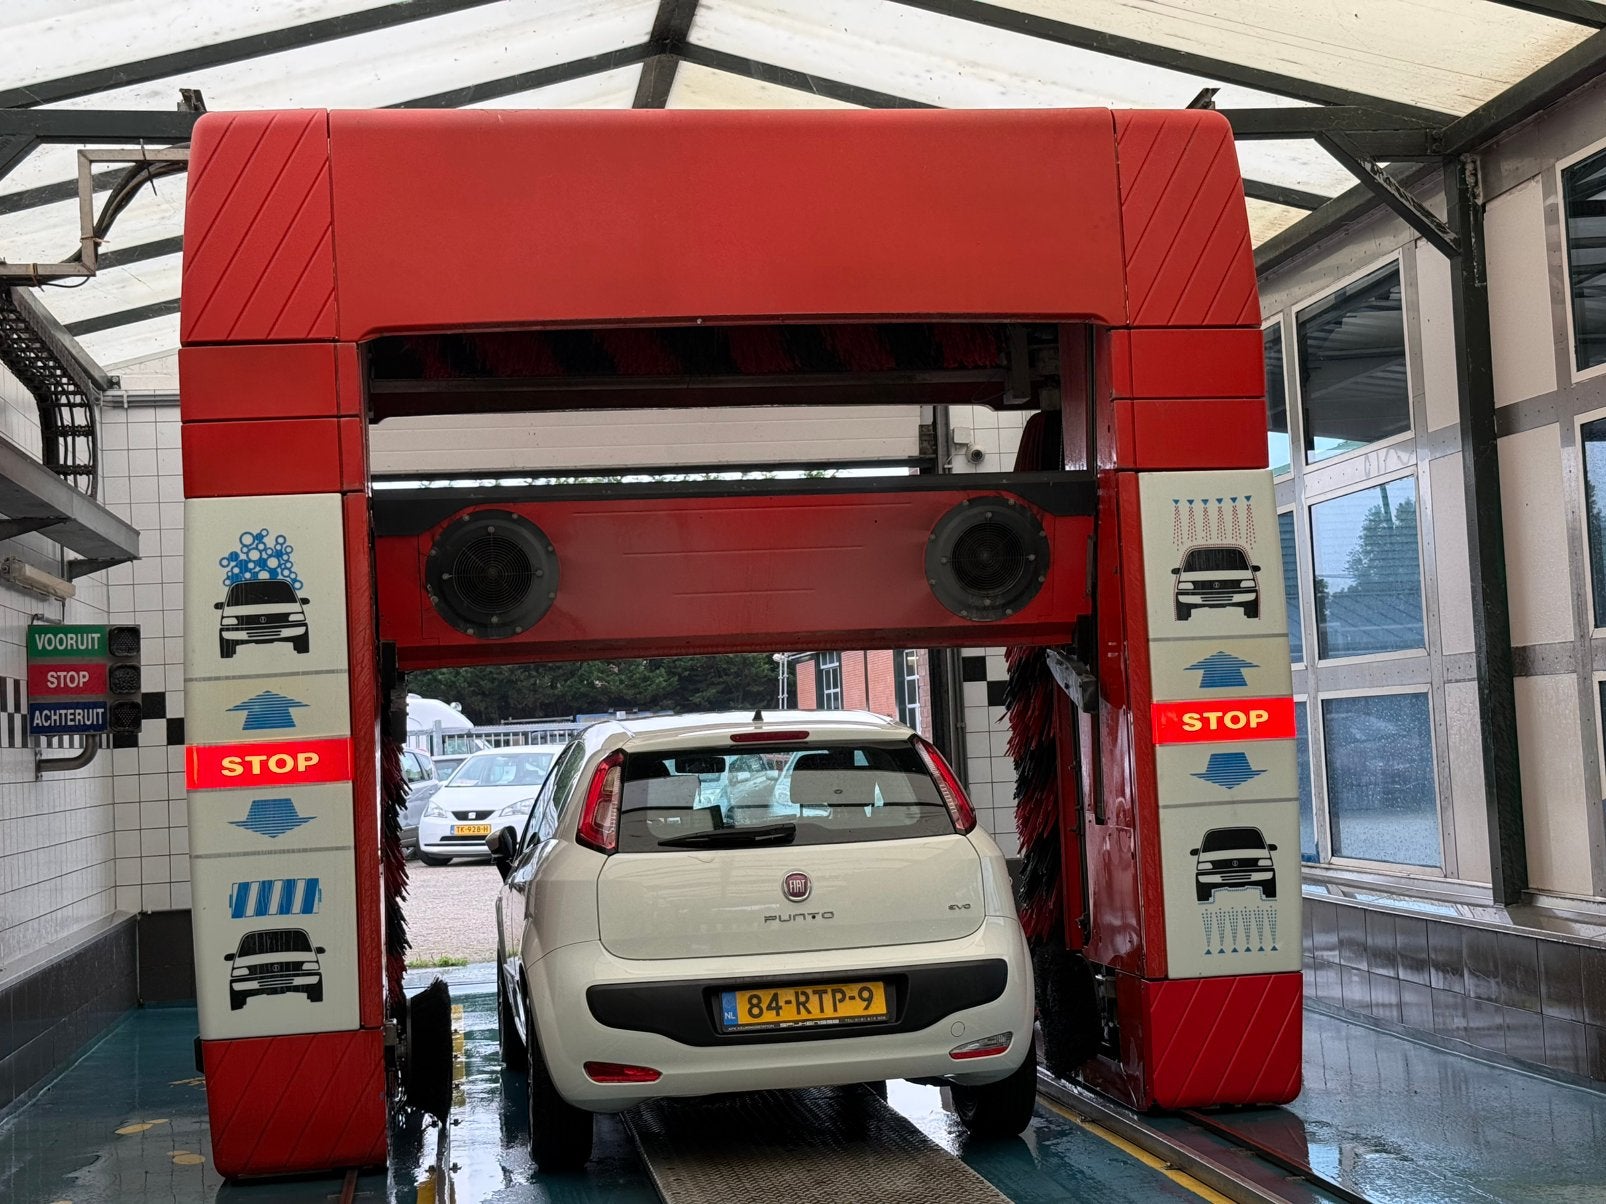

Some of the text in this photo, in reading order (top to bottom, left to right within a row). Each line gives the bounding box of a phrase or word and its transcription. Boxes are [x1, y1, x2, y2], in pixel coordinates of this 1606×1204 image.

[35, 633, 101, 650] VOORUIT
[47, 671, 89, 688] STOP
[33, 708, 105, 727] ACHTERUIT
[1182, 709, 1269, 732] STOP
[221, 752, 320, 777] STOP
[789, 879, 806, 893] FIAT
[764, 911, 835, 923] PUNTO
[724, 986, 874, 1019] NL 84-RTP-9
